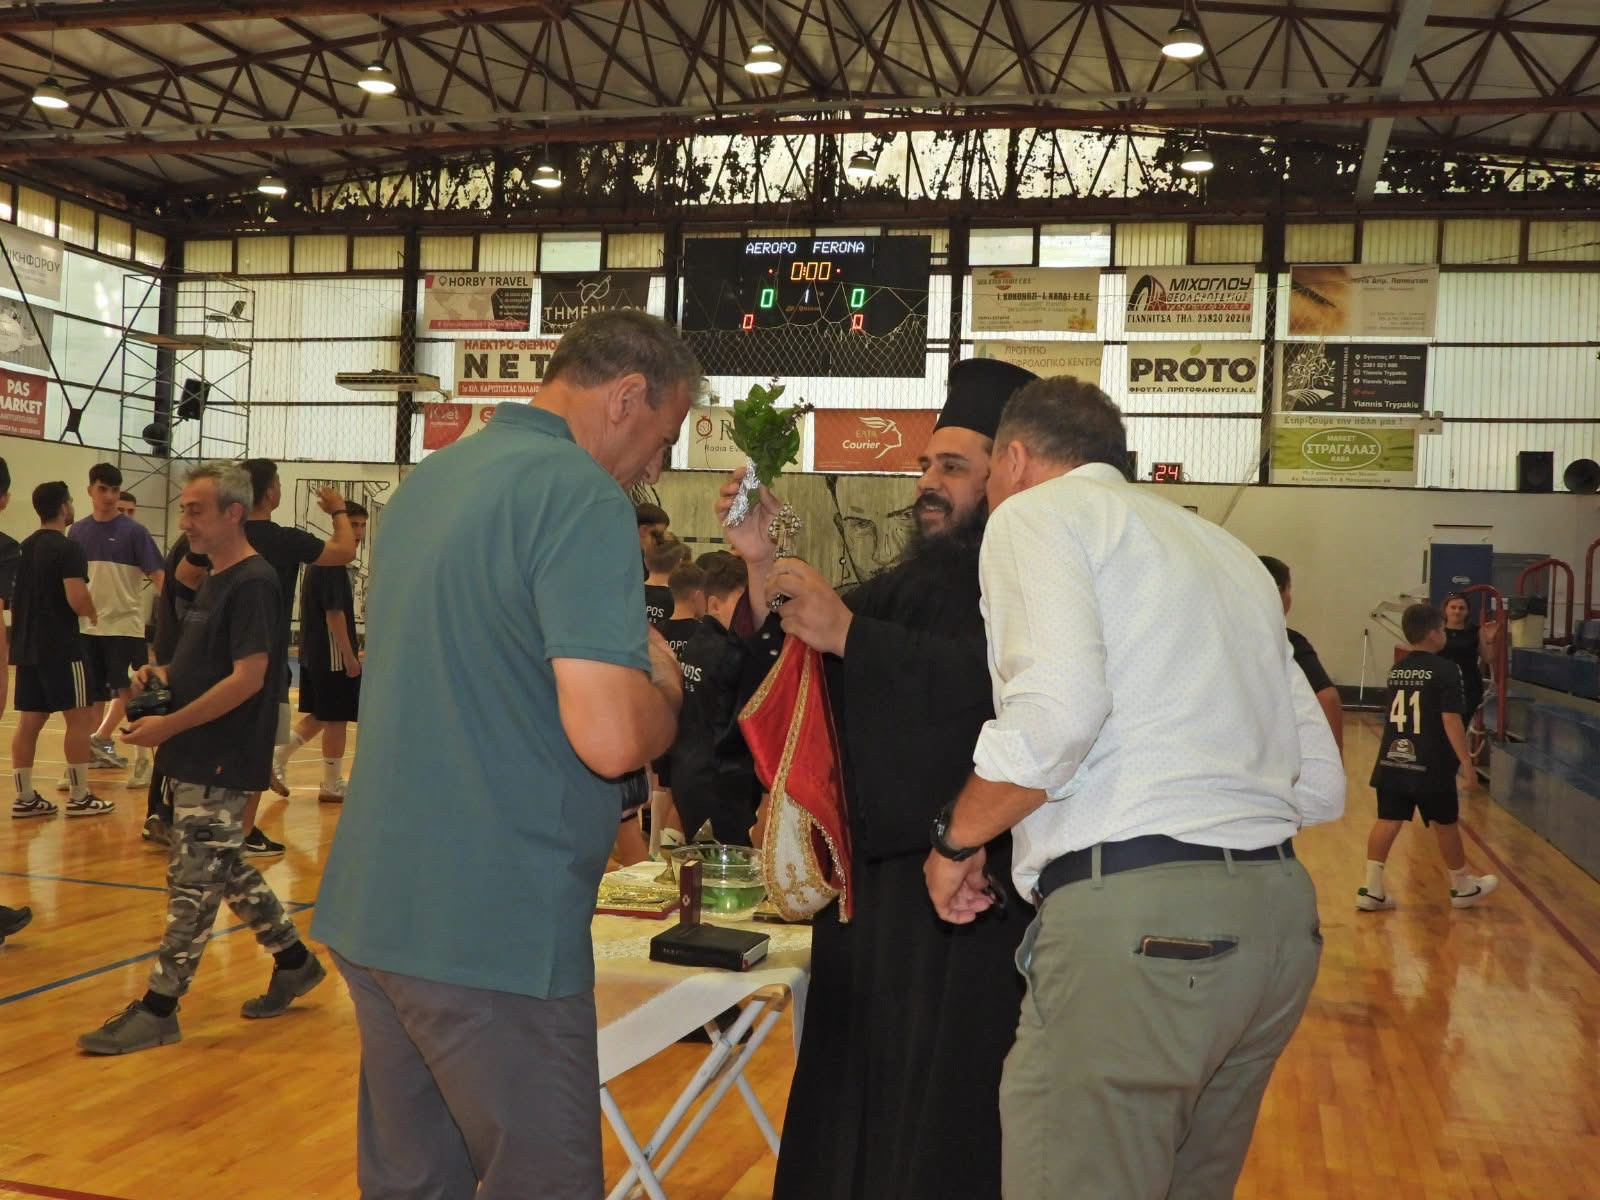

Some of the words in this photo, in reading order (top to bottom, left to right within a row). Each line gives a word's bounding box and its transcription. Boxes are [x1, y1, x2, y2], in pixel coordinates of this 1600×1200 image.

[745, 241, 798, 254] AEROPO
[812, 241, 865, 254] FERONA
[790, 261, 831, 281] 0:00
[449, 276, 486, 287] HORBY
[488, 276, 529, 286] TRAVEL
[1169, 277, 1252, 291] ΜΙΧΟΓΛΟΥ
[760, 288, 775, 308] 0
[805, 288, 810, 303] 1
[850, 288, 865, 308] 0
[742, 314, 754, 329] 0
[852, 314, 864, 329] 0
[1130, 358, 1256, 383] PROTO
[7, 379, 30, 397] PAS
[1384, 401, 1419, 409] Trypakis
[1284, 415, 1334, 426] Στηρίζουμε
[842, 439, 881, 449] Courier
[1306, 444, 1377, 455] ΣΤΡΑΓΑΛΑΣ
[1155, 465, 1178, 481] 24
[1389, 689, 1421, 735] 41
